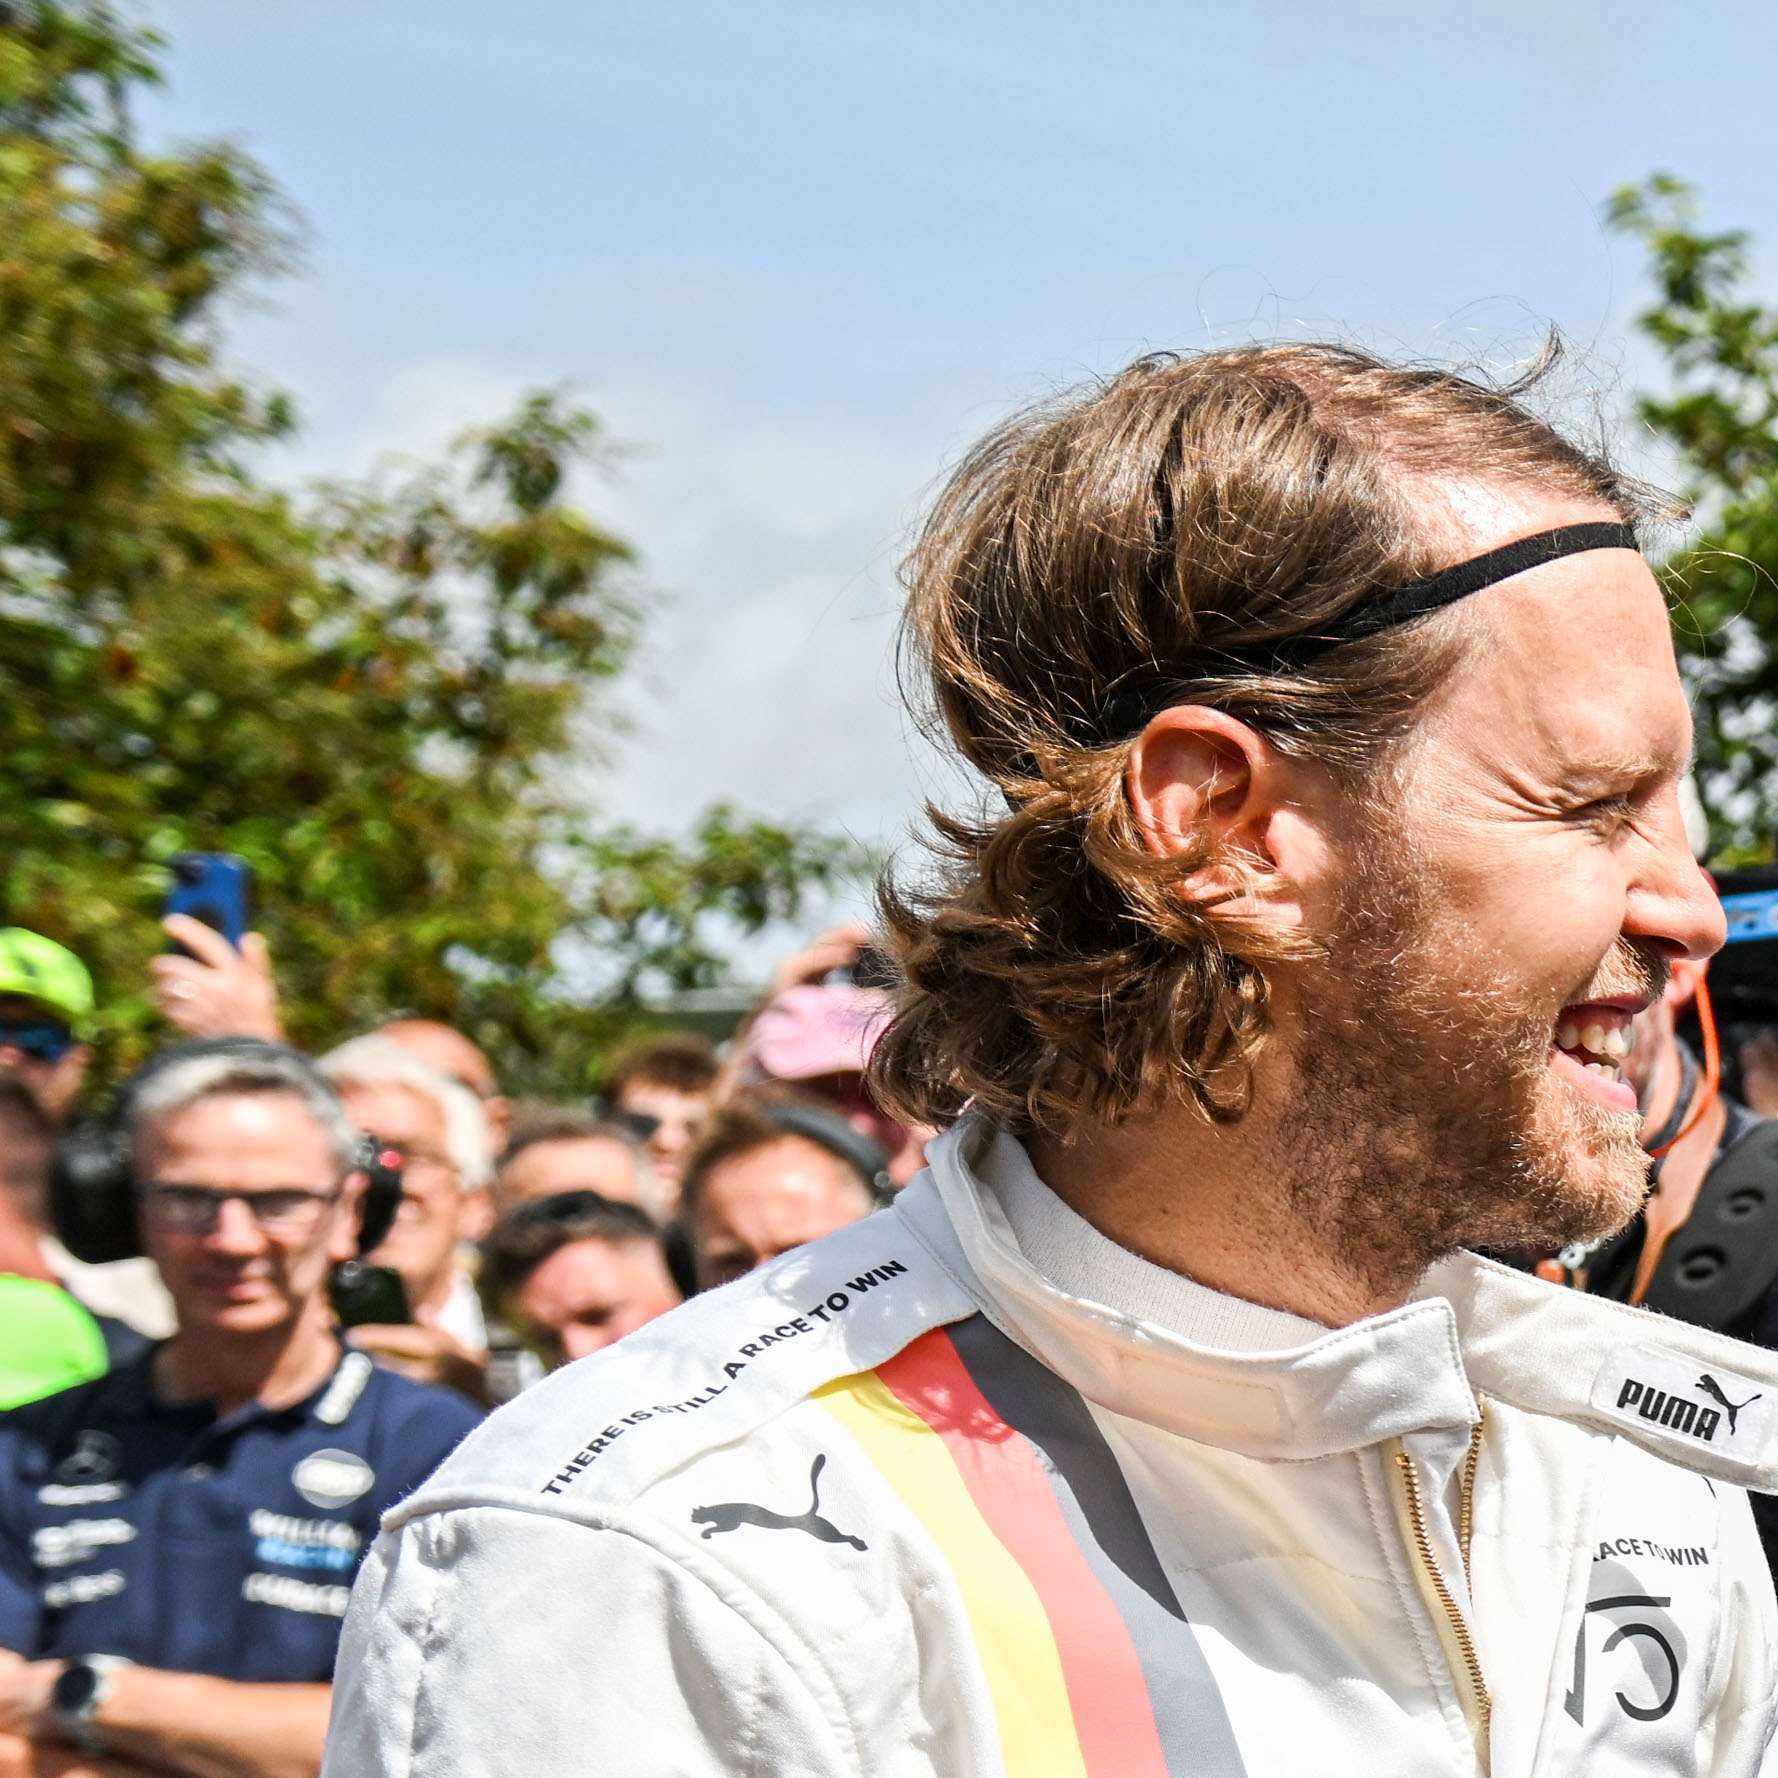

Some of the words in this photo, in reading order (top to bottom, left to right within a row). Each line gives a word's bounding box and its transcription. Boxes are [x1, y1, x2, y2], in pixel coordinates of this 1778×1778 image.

[541, 1425, 626, 1496] THERE
[620, 1408, 652, 1427] IS
[723, 1361, 746, 1380] A
[738, 1317, 815, 1358] RACE
[808, 1291, 850, 1324] TO
[846, 1259, 908, 1294] WIN
[1616, 1377, 1722, 1443] PUMA
[1593, 1538, 1643, 1562] ACE
[1664, 1546, 1710, 1566] WIN
